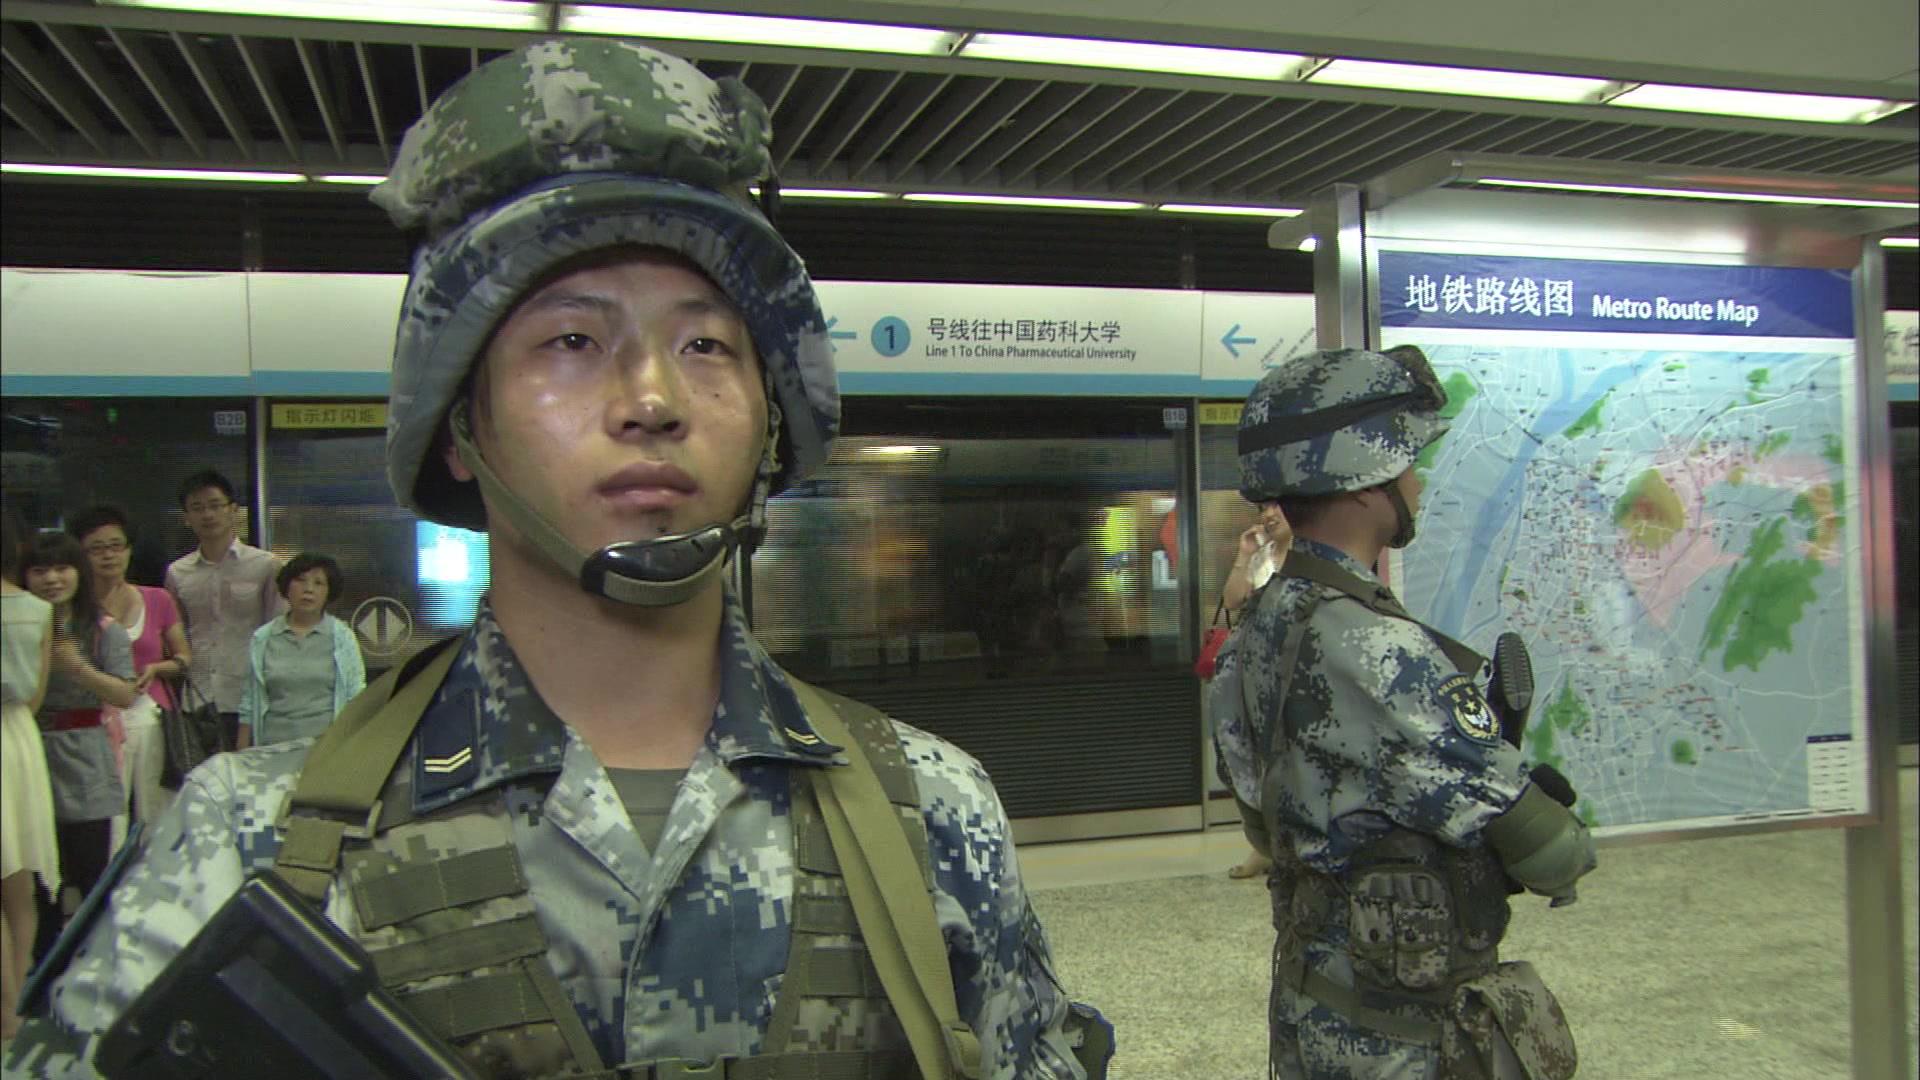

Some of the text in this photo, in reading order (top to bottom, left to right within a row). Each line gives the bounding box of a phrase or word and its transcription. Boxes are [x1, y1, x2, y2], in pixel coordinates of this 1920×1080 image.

[1404, 274, 1574, 318] 地铁路线图
[1592, 294, 1760, 327] Metro Route Map
[883, 324, 897, 350] 1
[927, 318, 1121, 343] 号线往中国药科大学
[925, 344, 1137, 361] Line 1 To China Pharmaceutical University
